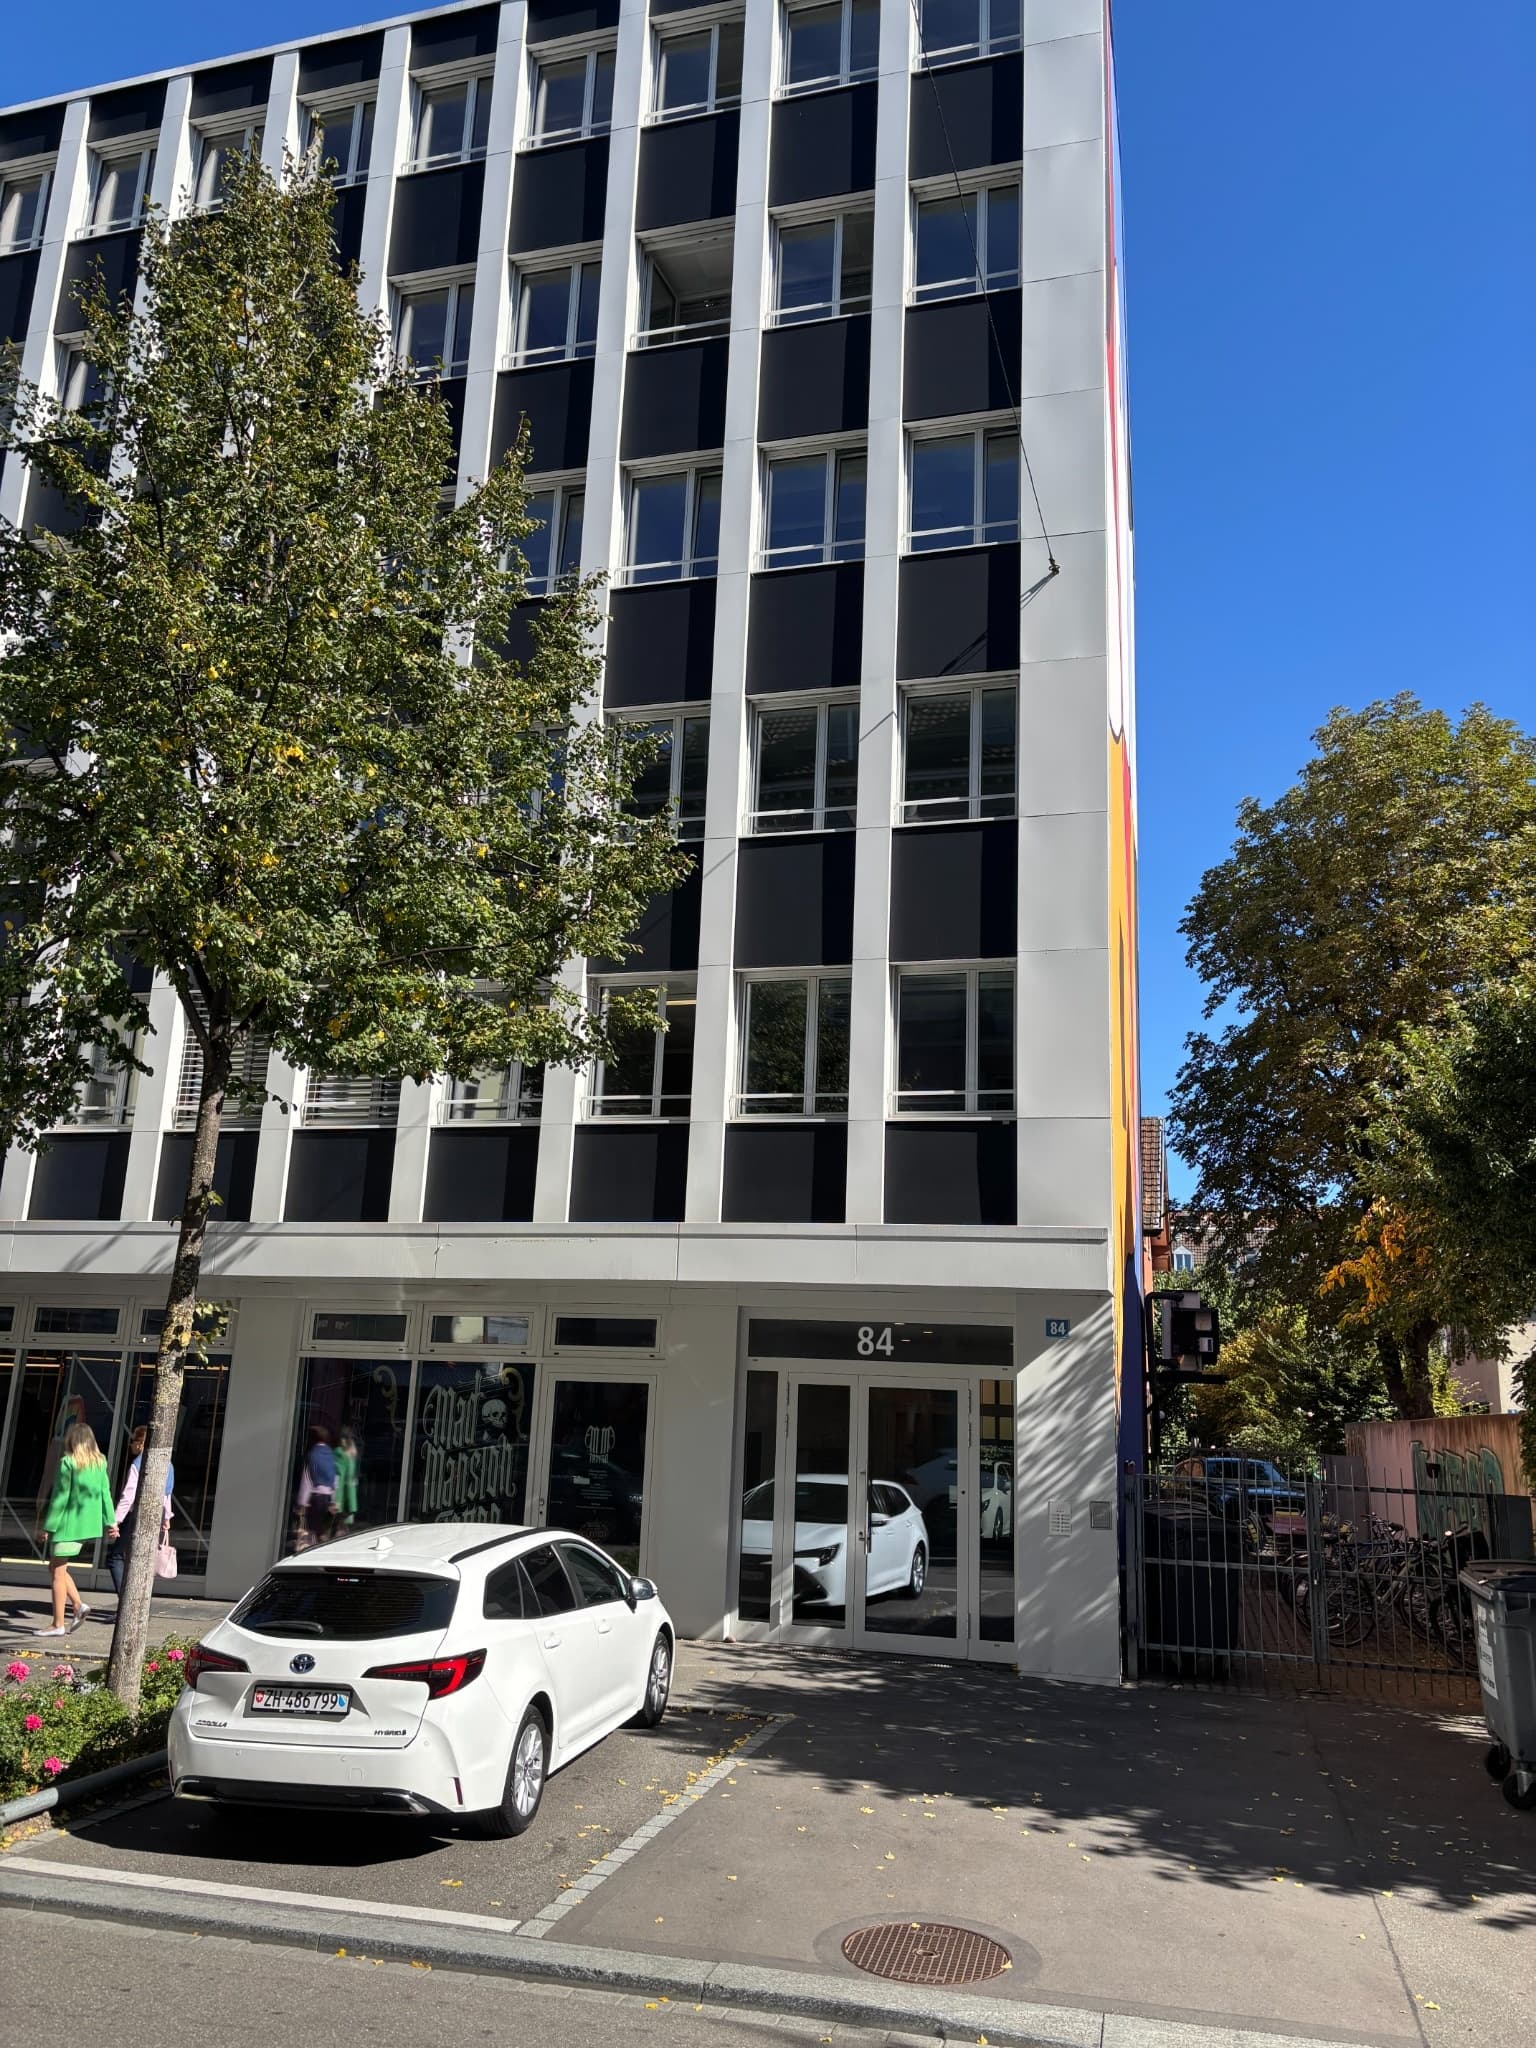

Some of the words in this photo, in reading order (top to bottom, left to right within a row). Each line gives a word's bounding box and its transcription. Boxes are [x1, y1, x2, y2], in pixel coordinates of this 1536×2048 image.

[857, 1326, 894, 1356] 84
[1050, 1321, 1066, 1335] 84
[422, 1369, 484, 1450] Mad
[420, 1433, 516, 1512] Mansion
